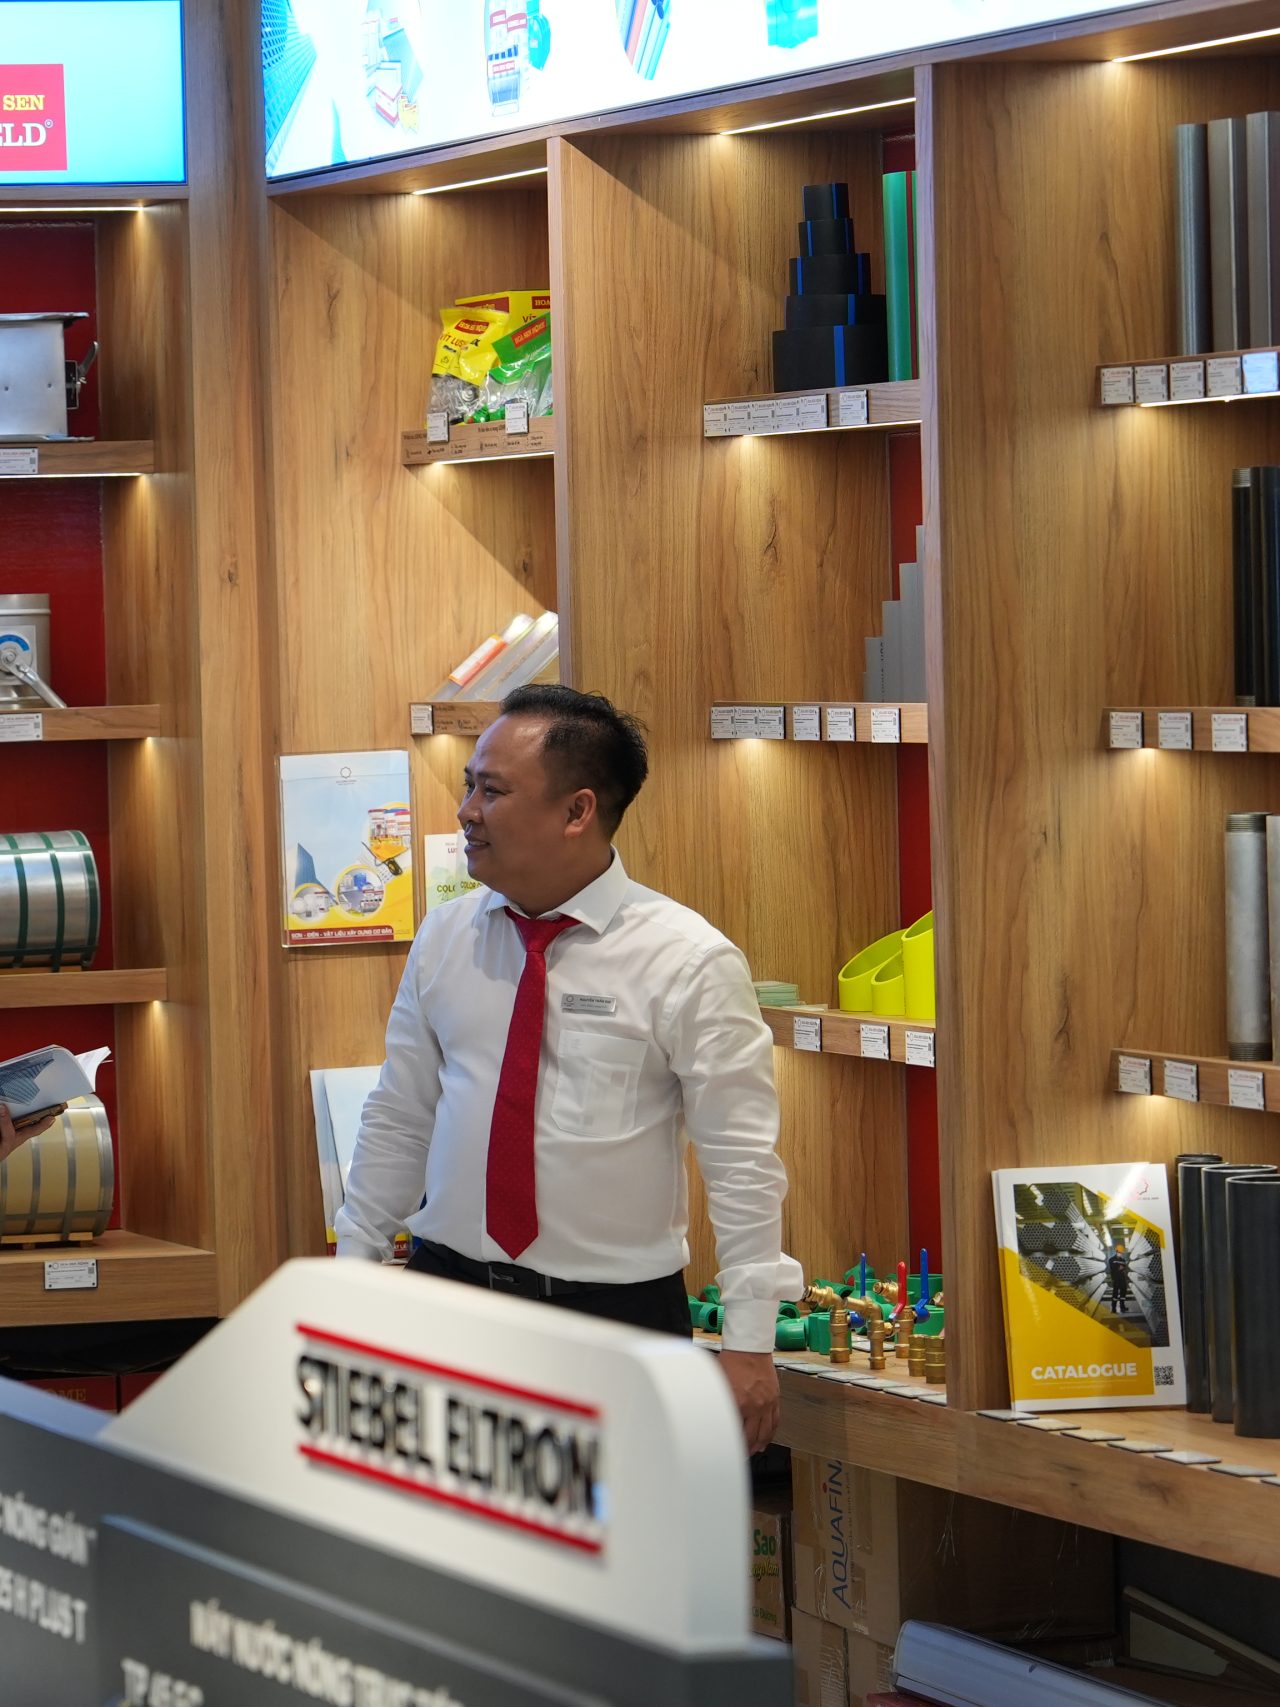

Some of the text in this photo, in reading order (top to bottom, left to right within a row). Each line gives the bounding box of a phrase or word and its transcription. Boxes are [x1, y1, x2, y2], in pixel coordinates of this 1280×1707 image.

[3, 94, 46, 111] SEN
[1031, 1362, 1138, 1381] CATALOGUE
[296, 1355, 600, 1517] STIEBEL ELTRON
[822, 1459, 852, 1610] AQUAFIN
